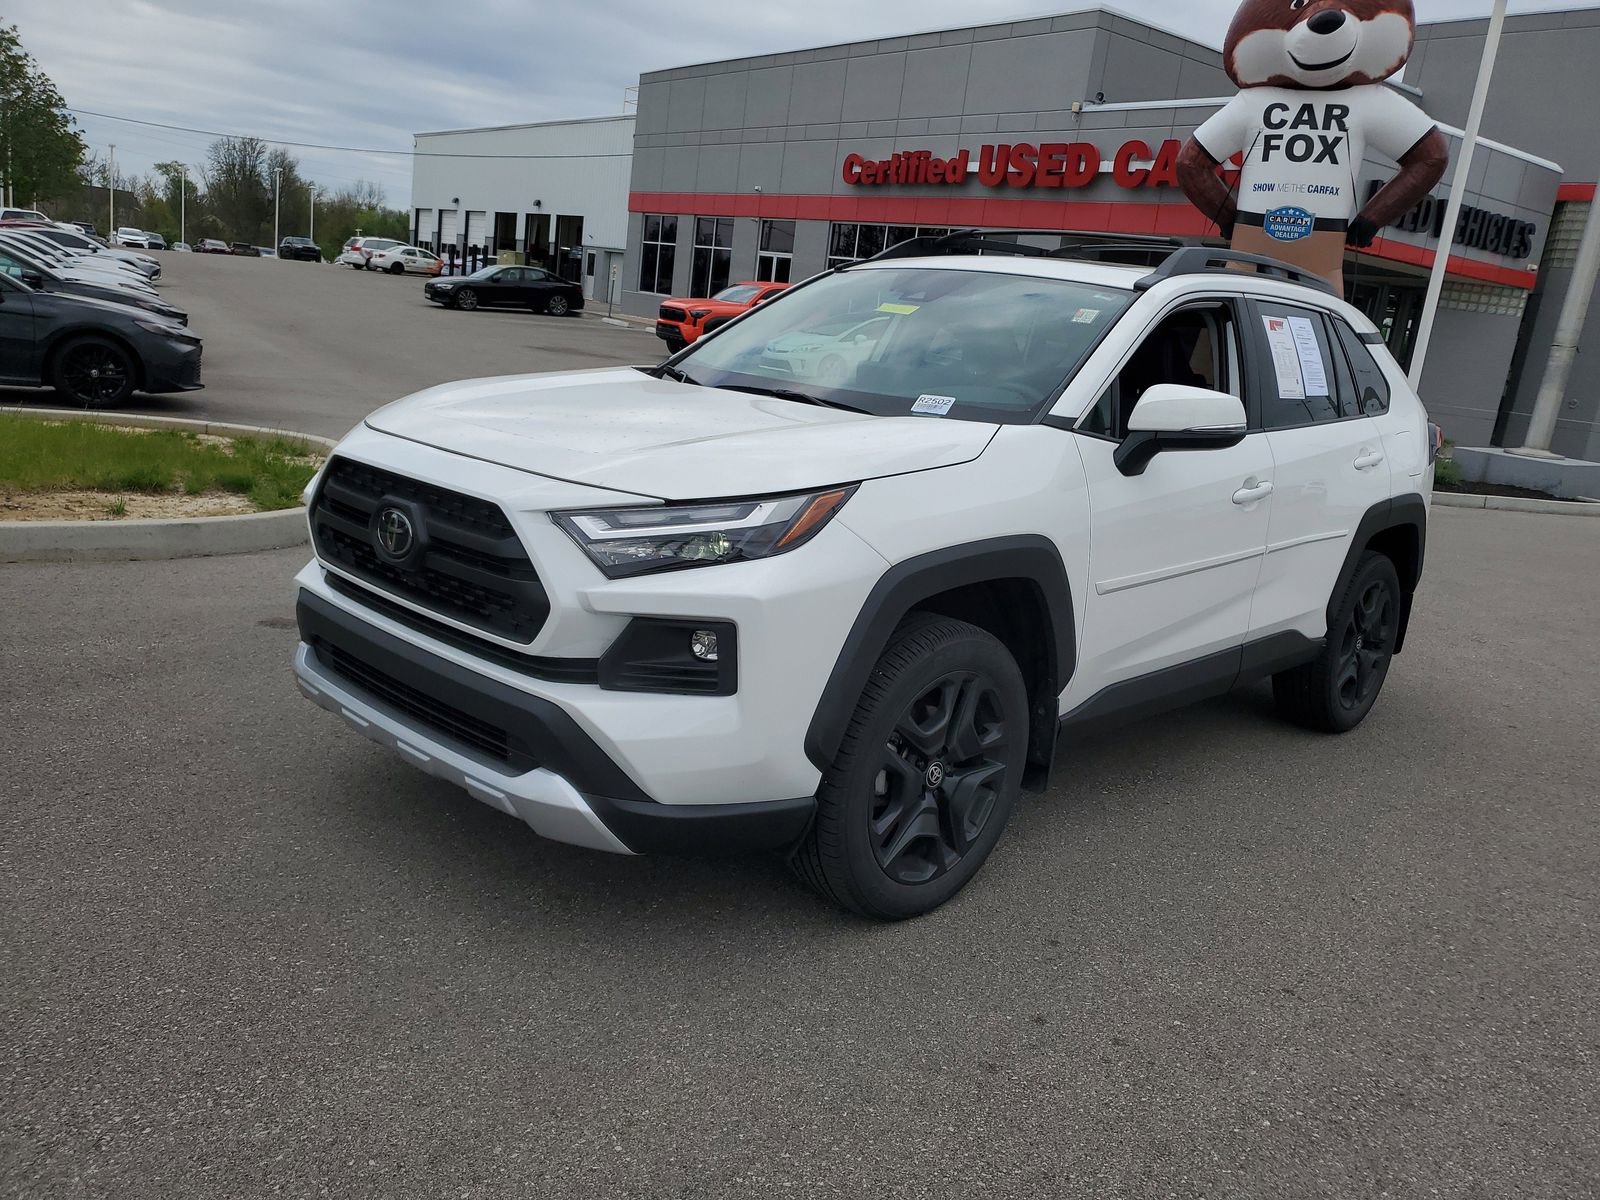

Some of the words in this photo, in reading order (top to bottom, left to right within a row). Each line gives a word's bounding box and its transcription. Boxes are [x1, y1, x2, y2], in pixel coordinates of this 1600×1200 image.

[1263, 102, 1350, 132] CAR
[1261, 133, 1344, 165] FOX
[842, 149, 970, 185] Certified
[977, 142, 1101, 190] USED
[1252, 183, 1275, 192] SHOW
[1276, 184, 1289, 192] ME
[1291, 184, 1306, 193] THE
[1307, 184, 1340, 196] CARFAX
[1268, 215, 1311, 226] CARFAX
[1269, 223, 1307, 233] ADVANTAGE
[1274, 231, 1299, 239] DEALER
[918, 396, 952, 405] R2502
